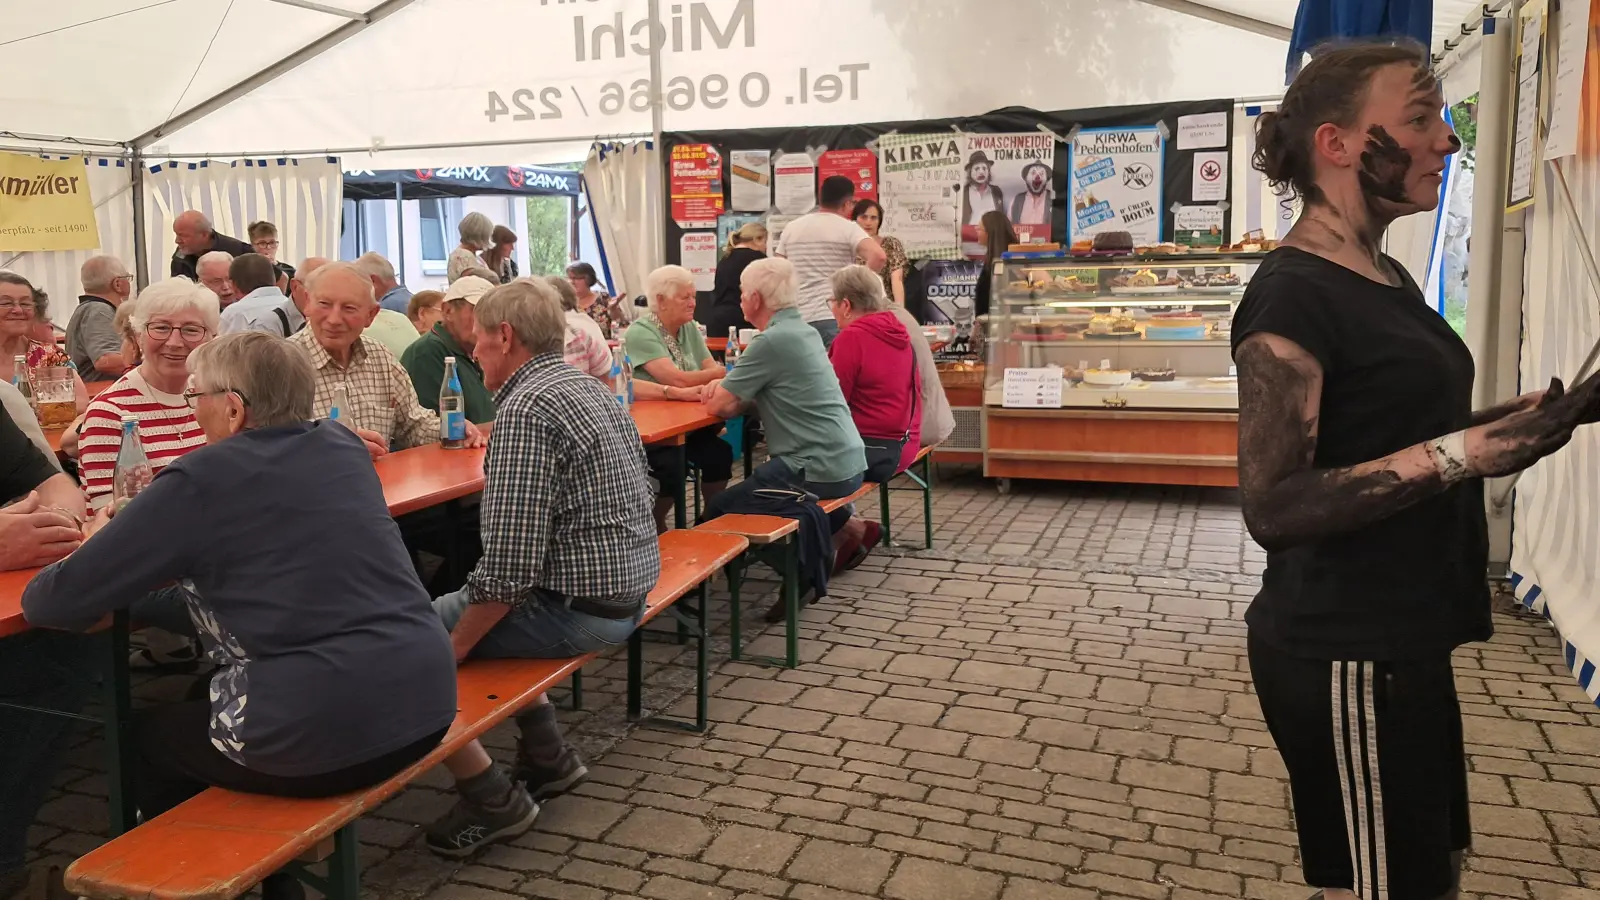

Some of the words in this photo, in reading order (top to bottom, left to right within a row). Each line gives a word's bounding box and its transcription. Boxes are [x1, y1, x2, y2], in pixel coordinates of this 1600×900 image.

[968, 135, 1051, 149] ZWOASCHNEIDIG
[1095, 132, 1137, 144] KIRWA
[884, 140, 960, 165] KIRWA
[994, 149, 1014, 160] TOM
[1024, 148, 1051, 159] BASTI
[1080, 143, 1152, 154] Pelchenhofen
[885, 156, 961, 173] OBERBUCHFELD
[1075, 160, 1112, 178] Samstag
[436, 166, 490, 182] 24MX
[526, 171, 569, 191] 24MX
[911, 212, 936, 221] CASE
[1077, 202, 1108, 219] Montag
[1122, 206, 1155, 224] BOUM
[64, 224, 88, 232] 1490!
